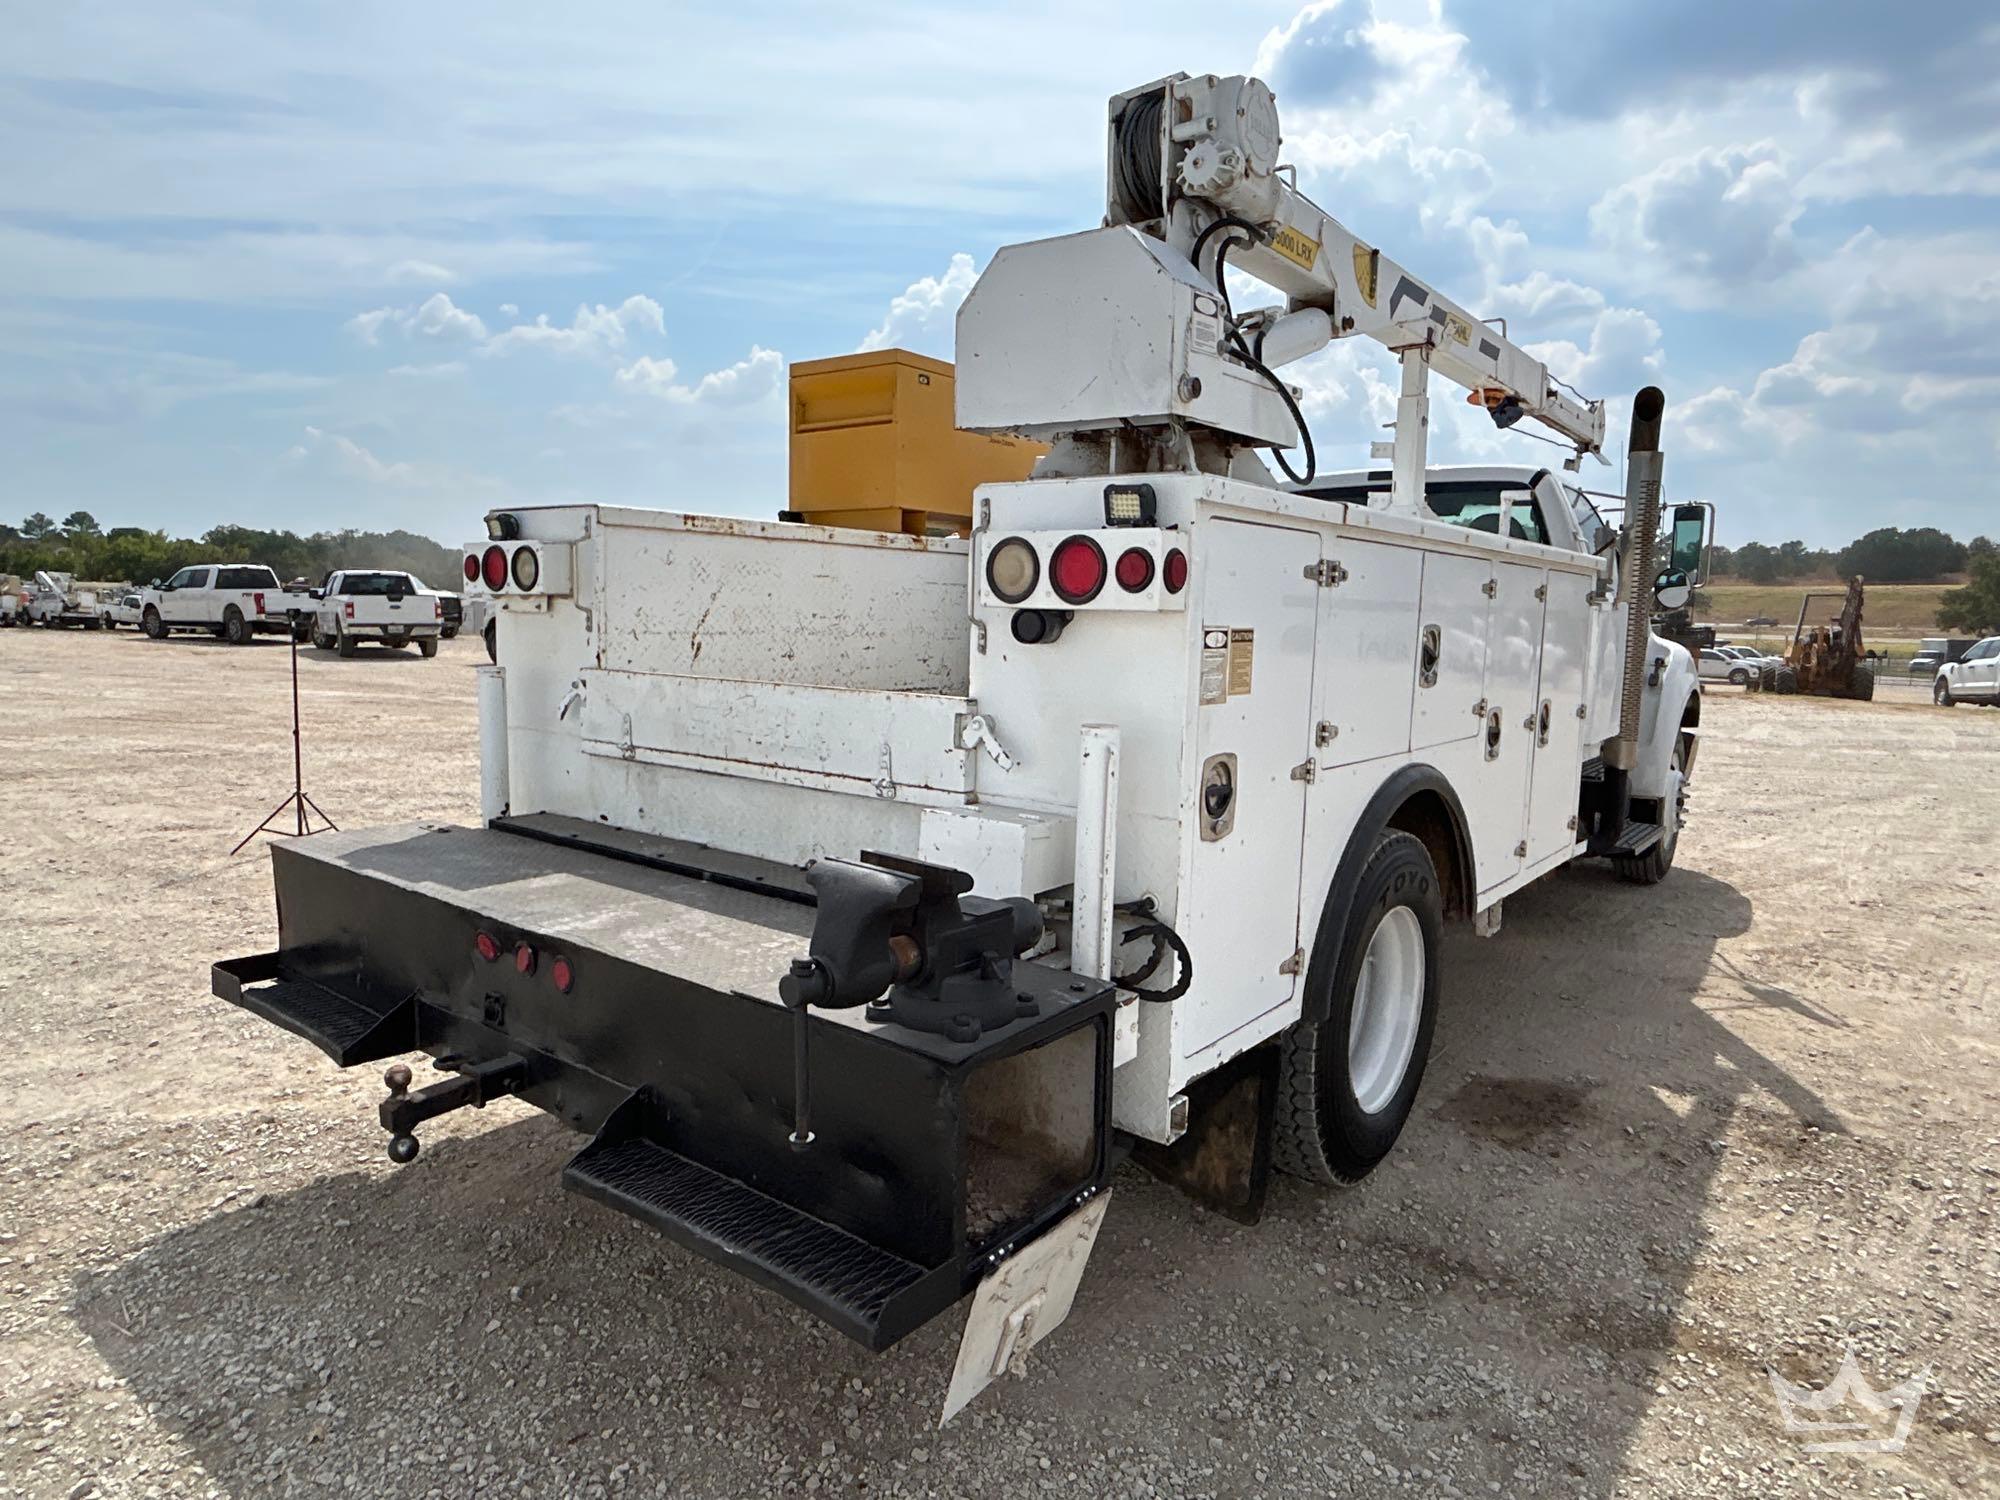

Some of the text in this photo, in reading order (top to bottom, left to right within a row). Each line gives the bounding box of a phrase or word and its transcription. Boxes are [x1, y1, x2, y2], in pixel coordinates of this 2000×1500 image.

[1296, 240, 1312, 265] LRX
[1231, 631, 1252, 641] CAUTION
[1379, 870, 1429, 908] TOYO
